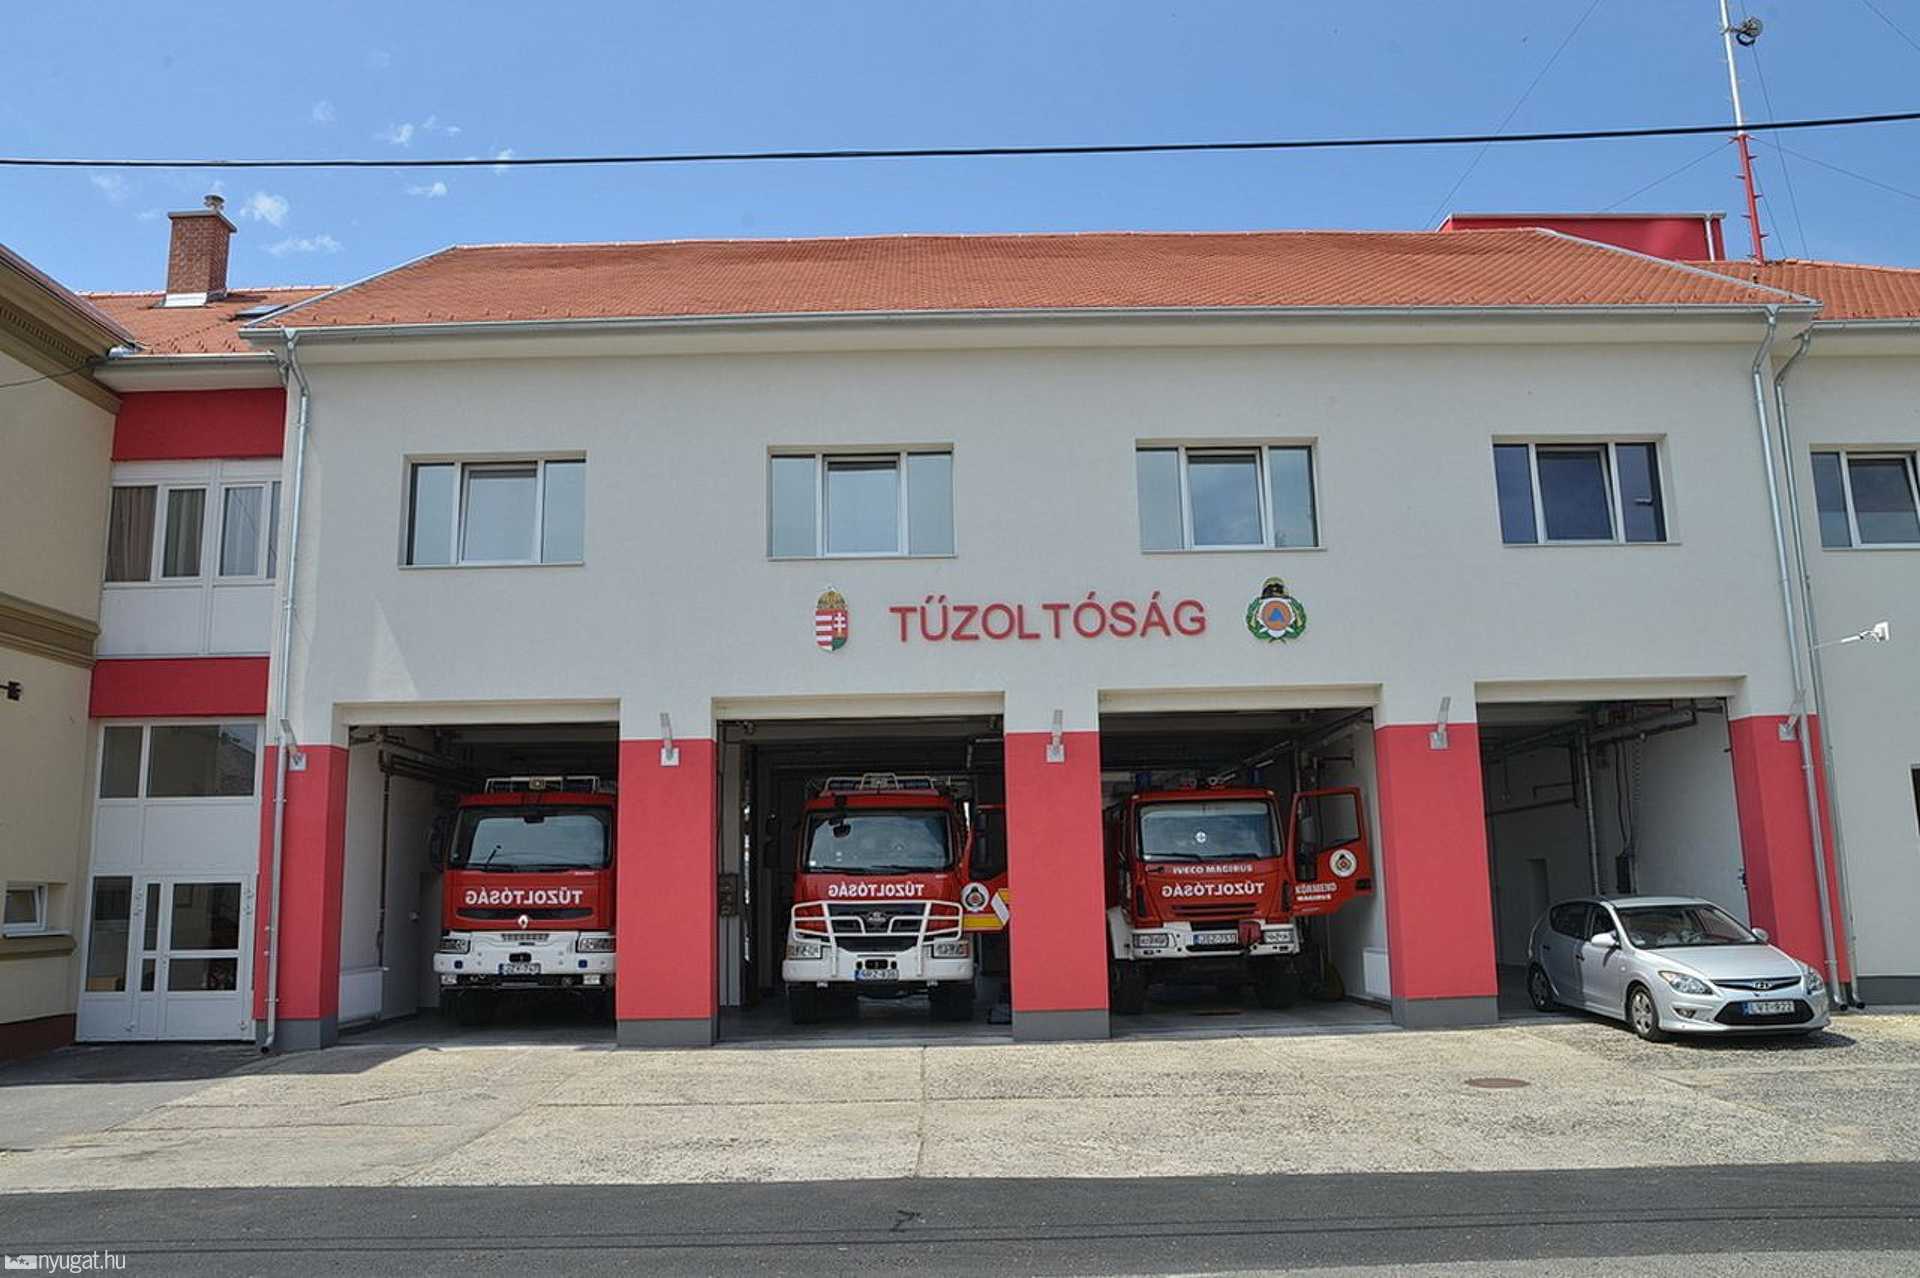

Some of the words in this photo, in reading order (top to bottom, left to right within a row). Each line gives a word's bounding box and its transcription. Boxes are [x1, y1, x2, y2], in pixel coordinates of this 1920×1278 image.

[889, 591, 1207, 642] TŰZOLTÓSÁG
[1172, 865, 1204, 875] IVECO
[1205, 864, 1253, 874] MAGIRUS
